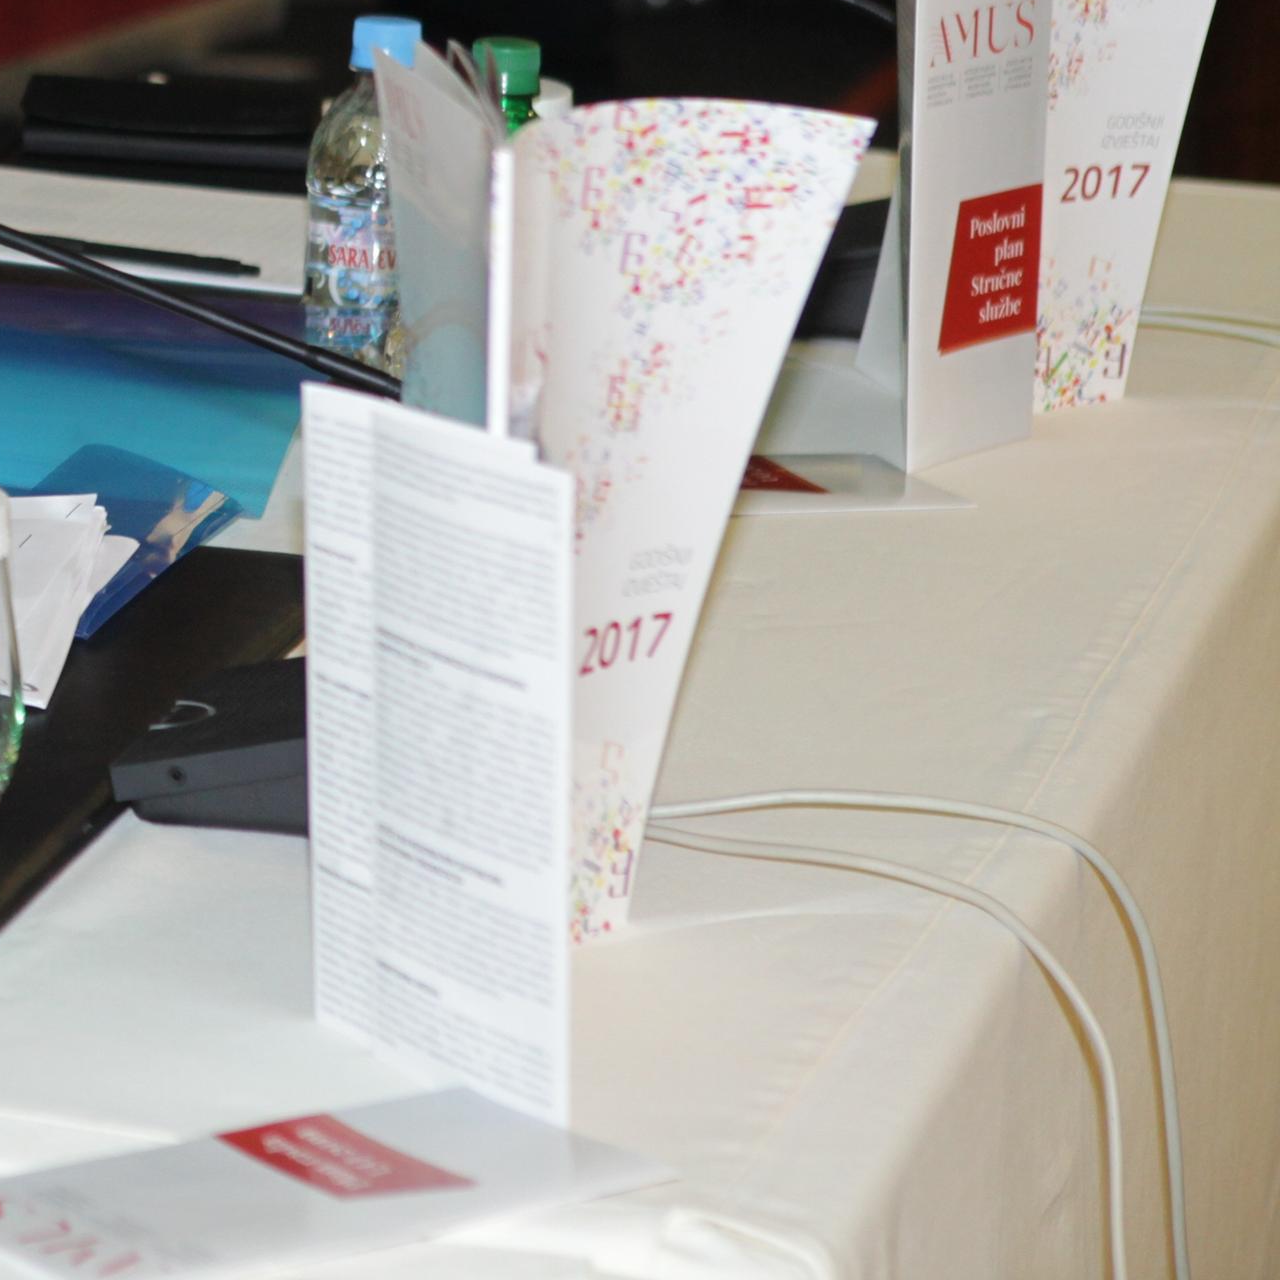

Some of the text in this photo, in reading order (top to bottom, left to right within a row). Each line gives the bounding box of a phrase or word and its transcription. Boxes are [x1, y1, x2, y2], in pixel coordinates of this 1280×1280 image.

[1060, 162, 1151, 204] 2017
[969, 204, 1026, 239] Poslovni
[994, 236, 1024, 267] plan
[970, 267, 1023, 297] Stručne
[978, 295, 1022, 324] službe
[578, 612, 673, 677] 2017
